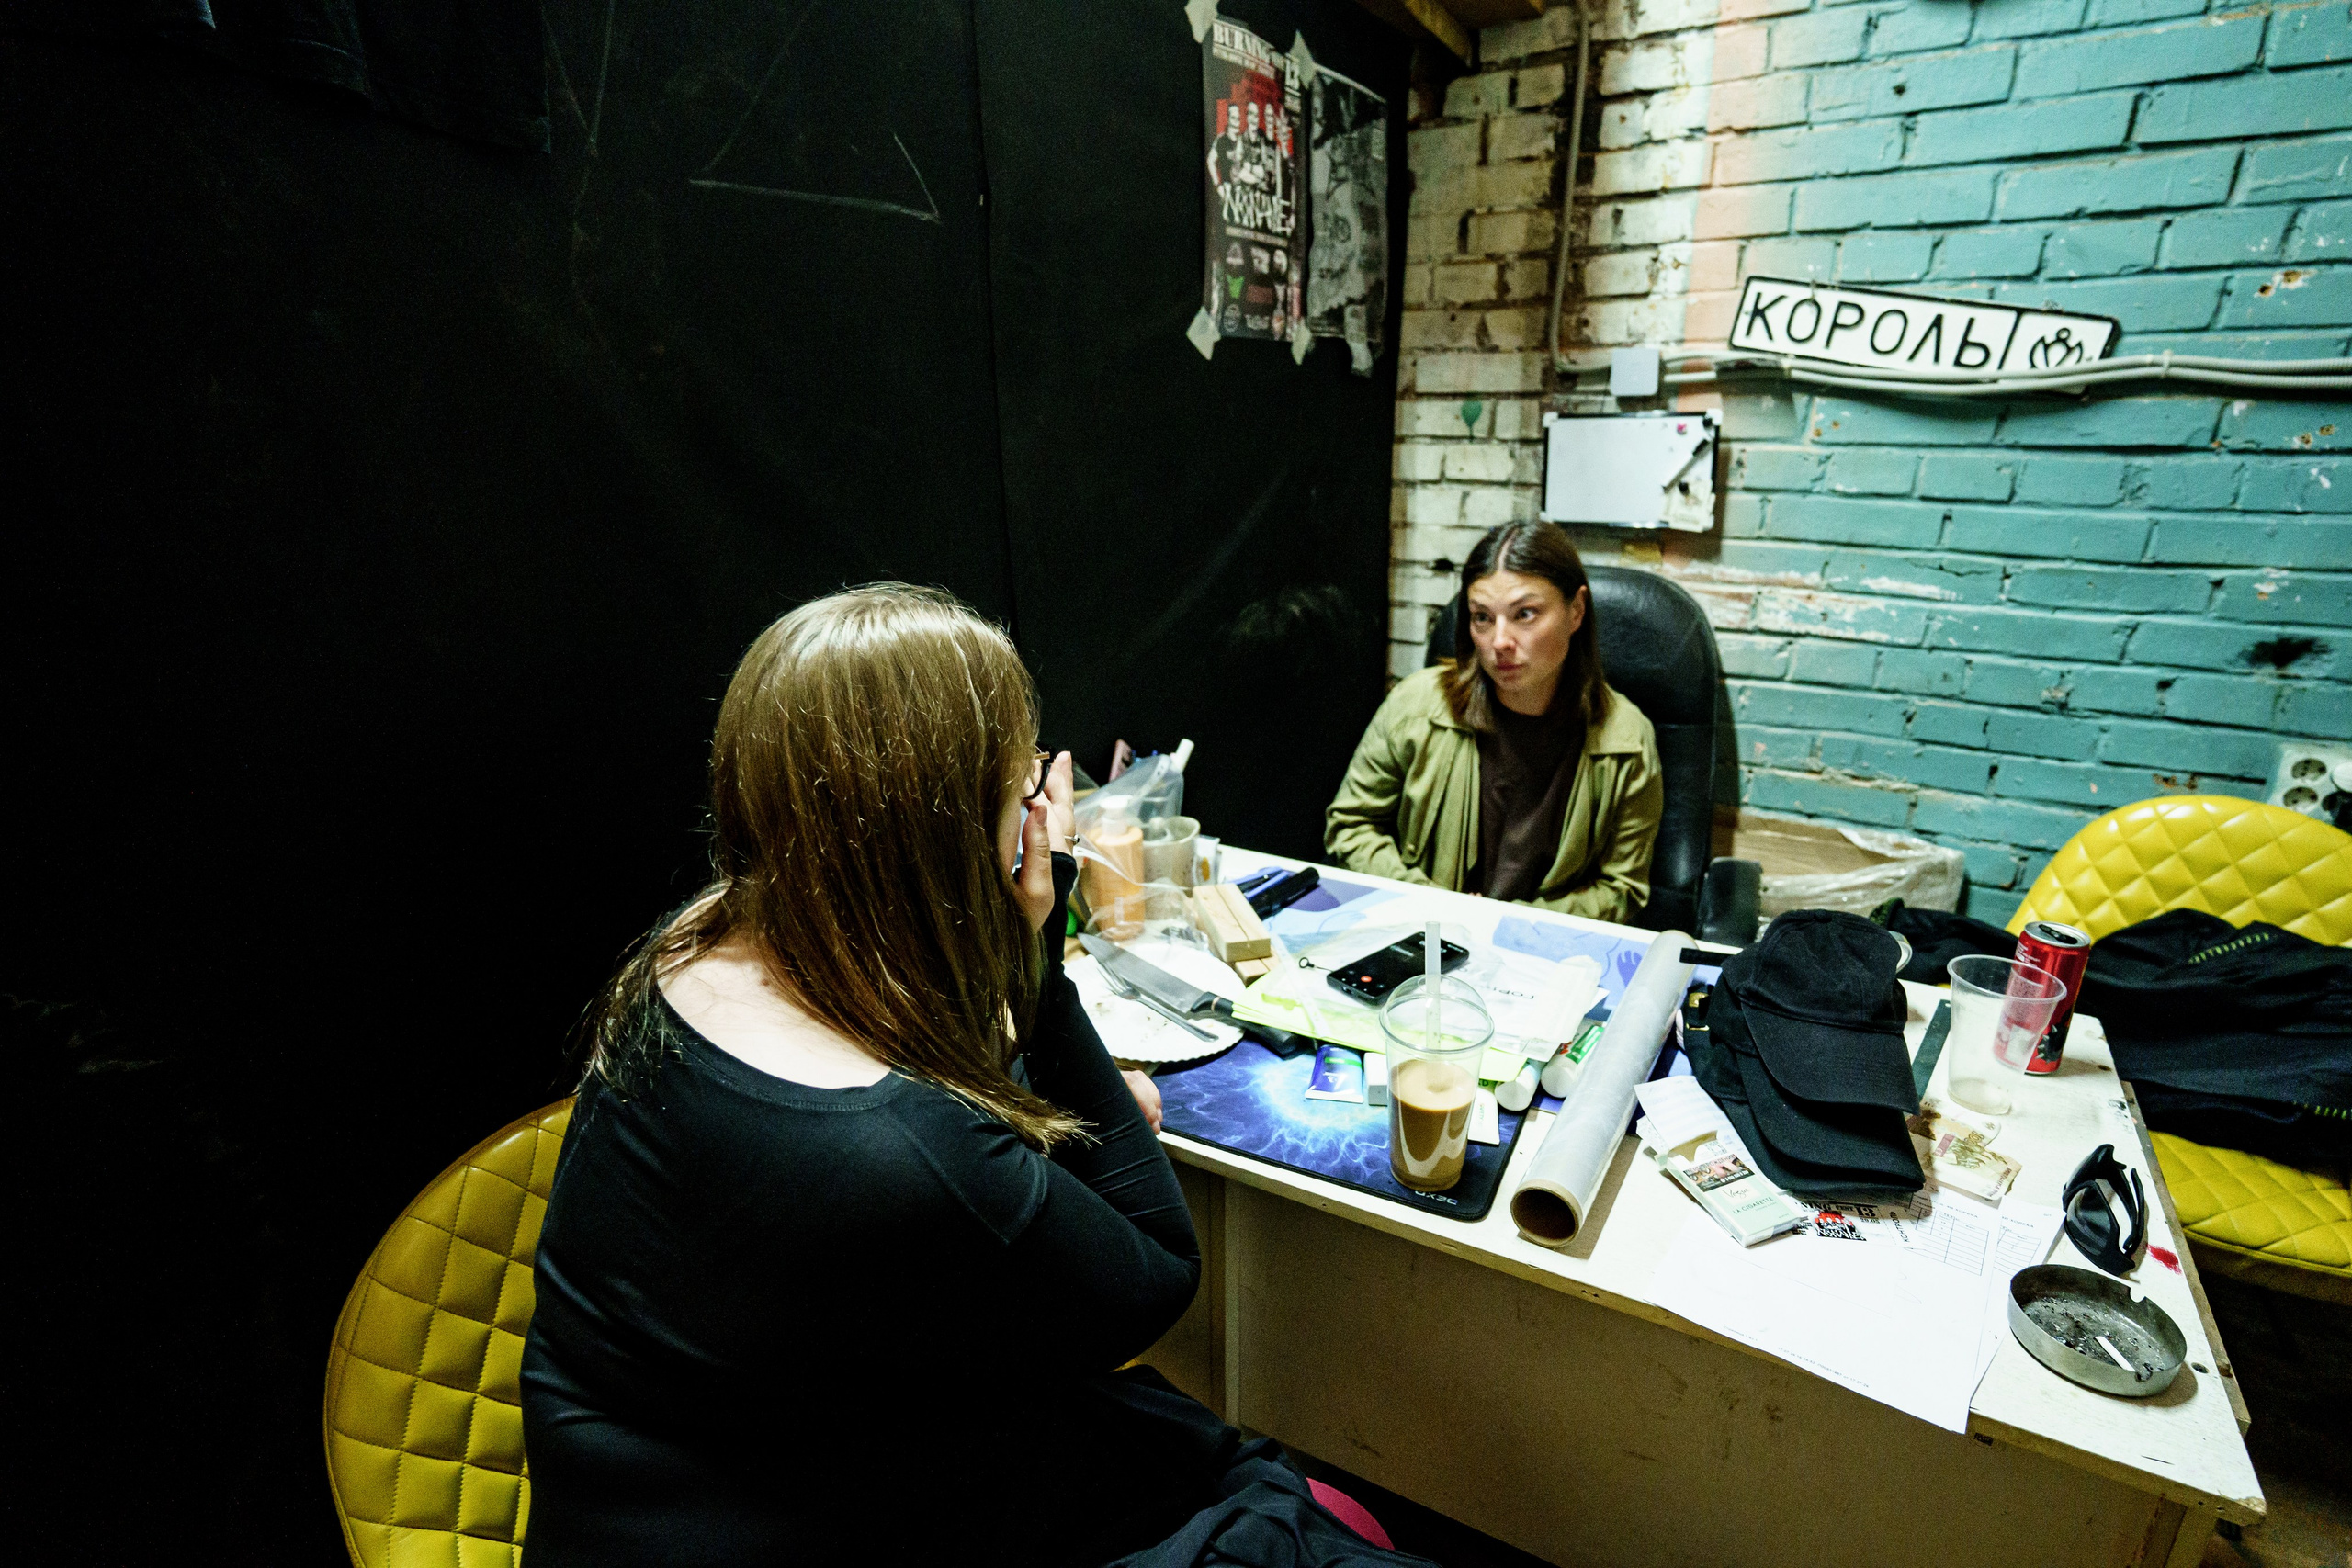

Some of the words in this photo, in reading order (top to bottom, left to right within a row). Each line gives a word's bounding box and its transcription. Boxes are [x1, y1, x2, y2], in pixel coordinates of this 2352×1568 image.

[1745, 291, 1992, 369] КОРОЛЬ
[1733, 1207, 1741, 1215] LA
[1741, 1196, 1775, 1213] CIGARETTE
[1889, 1211, 1911, 1244] КОНТРОЛЬ
